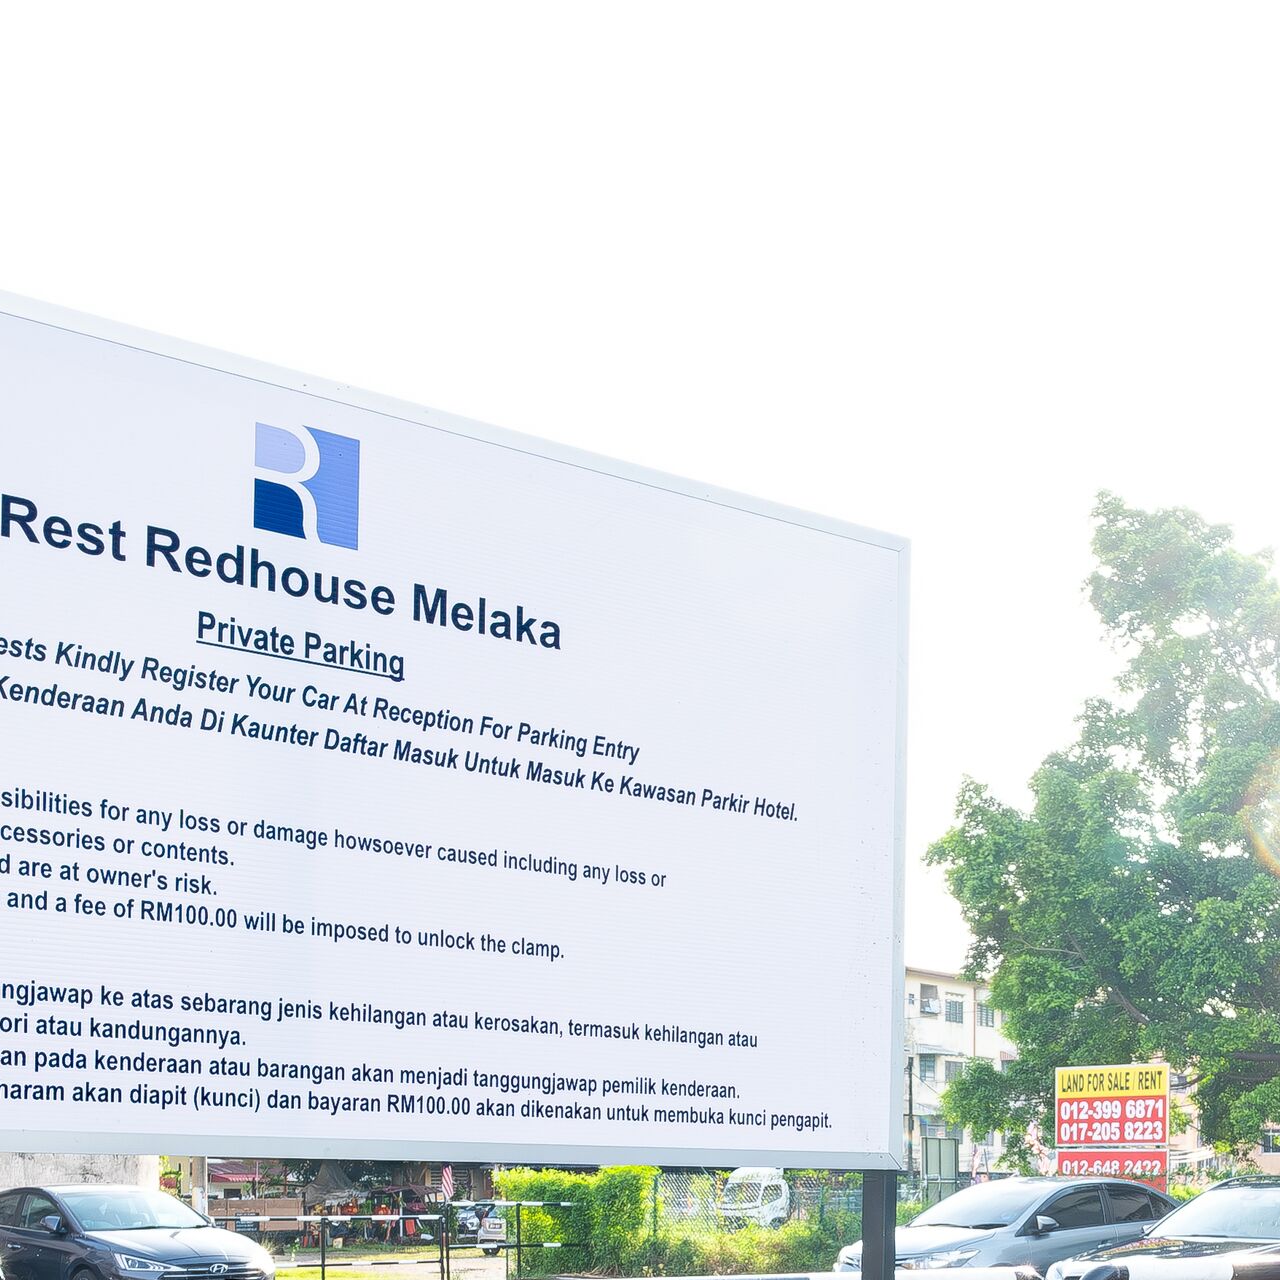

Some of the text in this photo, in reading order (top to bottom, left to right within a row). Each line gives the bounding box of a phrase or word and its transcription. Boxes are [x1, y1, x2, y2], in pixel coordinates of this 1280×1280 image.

[0, 492, 561, 650] Rest Redhouse Melaka
[196, 609, 405, 682] Private Parking
[54, 640, 135, 682] Kindly
[139, 655, 240, 694] Register
[245, 673, 297, 704] Your
[301, 684, 340, 711] Car
[341, 691, 368, 717] At
[372, 696, 474, 734] Reception
[478, 714, 513, 740] For
[516, 721, 588, 758] Parking
[591, 734, 640, 766] Entry
[129, 696, 193, 728] Anda
[198, 707, 226, 733] Di
[229, 711, 320, 747] Kaunter
[323, 727, 389, 758] Daftar
[392, 738, 459, 770] Masuk
[463, 749, 521, 779] Untuk
[525, 759, 586, 789] Masuk
[589, 769, 615, 793] Ke
[618, 774, 696, 806] Kawasan
[700, 787, 750, 814] Parkir
[752, 796, 798, 822] Hotel.
[98, 798, 130, 822] for
[135, 807, 173, 832] any
[179, 808, 220, 833] loss
[226, 819, 248, 836] or
[252, 818, 328, 850] damage
[333, 828, 432, 859] howsoever
[436, 845, 498, 867] caused
[502, 849, 578, 882] including
[581, 863, 611, 885] any
[614, 864, 646, 885] loss
[650, 872, 667, 887] or
[112, 837, 135, 854] or
[140, 840, 234, 866] contents.
[17, 859, 53, 879] are
[58, 861, 80, 882] at
[85, 866, 168, 891] owner's
[174, 871, 217, 896] risk.
[6, 889, 48, 911] and
[54, 895, 67, 913] a
[72, 892, 106, 916] fee
[112, 897, 135, 919] of
[140, 899, 237, 929] RM100.00
[242, 910, 276, 932] will
[281, 913, 305, 935] be
[310, 915, 389, 943] imposed
[394, 925, 412, 945] to
[417, 928, 475, 950] unlock
[479, 933, 506, 953] the
[510, 936, 564, 962] clamp.
[34, 1014, 82, 1037] atau
[89, 1016, 246, 1050] kandungannya.
[99, 984, 124, 1007] ke
[130, 988, 174, 1010] atas
[179, 991, 272, 1022] sebarang
[275, 996, 323, 1022] jenis
[328, 1000, 426, 1030] kehilangan
[431, 1009, 468, 1029] atau
[473, 1010, 563, 1038] kerosakan,
[567, 1018, 640, 1040] termasuk
[643, 1022, 724, 1049] kehilangan
[727, 1030, 758, 1048] atau
[33, 1047, 87, 1072] pada
[93, 1048, 202, 1074] kenderaan
[208, 1056, 250, 1077] atau
[256, 1056, 345, 1085] barangan
[350, 1062, 394, 1083] akan
[399, 1065, 468, 1090] menjadi
[471, 1068, 597, 1097] tanggungjawap
[601, 1076, 657, 1097] pemilik
[660, 1077, 740, 1099] kenderaan.
[1061, 1074, 1085, 1093] LAND
[1087, 1073, 1105, 1092] FOR
[1107, 1072, 1130, 1091] SALE
[1138, 1070, 1163, 1090] RENT
[71, 1080, 122, 1103] akan
[128, 1082, 187, 1110] diapit
[192, 1085, 261, 1113] (kunci)
[266, 1088, 301, 1110] dan
[307, 1089, 381, 1116] bayaran
[386, 1093, 471, 1115] RM100.00
[475, 1097, 515, 1117] akan
[519, 1098, 601, 1120] dikenakan
[606, 1103, 649, 1122] untuk
[653, 1105, 724, 1125] membuka
[728, 1107, 766, 1126] kunci
[769, 1111, 832, 1132] pengapit.
[1060, 1099, 1164, 1120] 012-399 6871
[1060, 1121, 1163, 1142] 017-205 8223
[1061, 1160, 1120, 1175] 012-648
